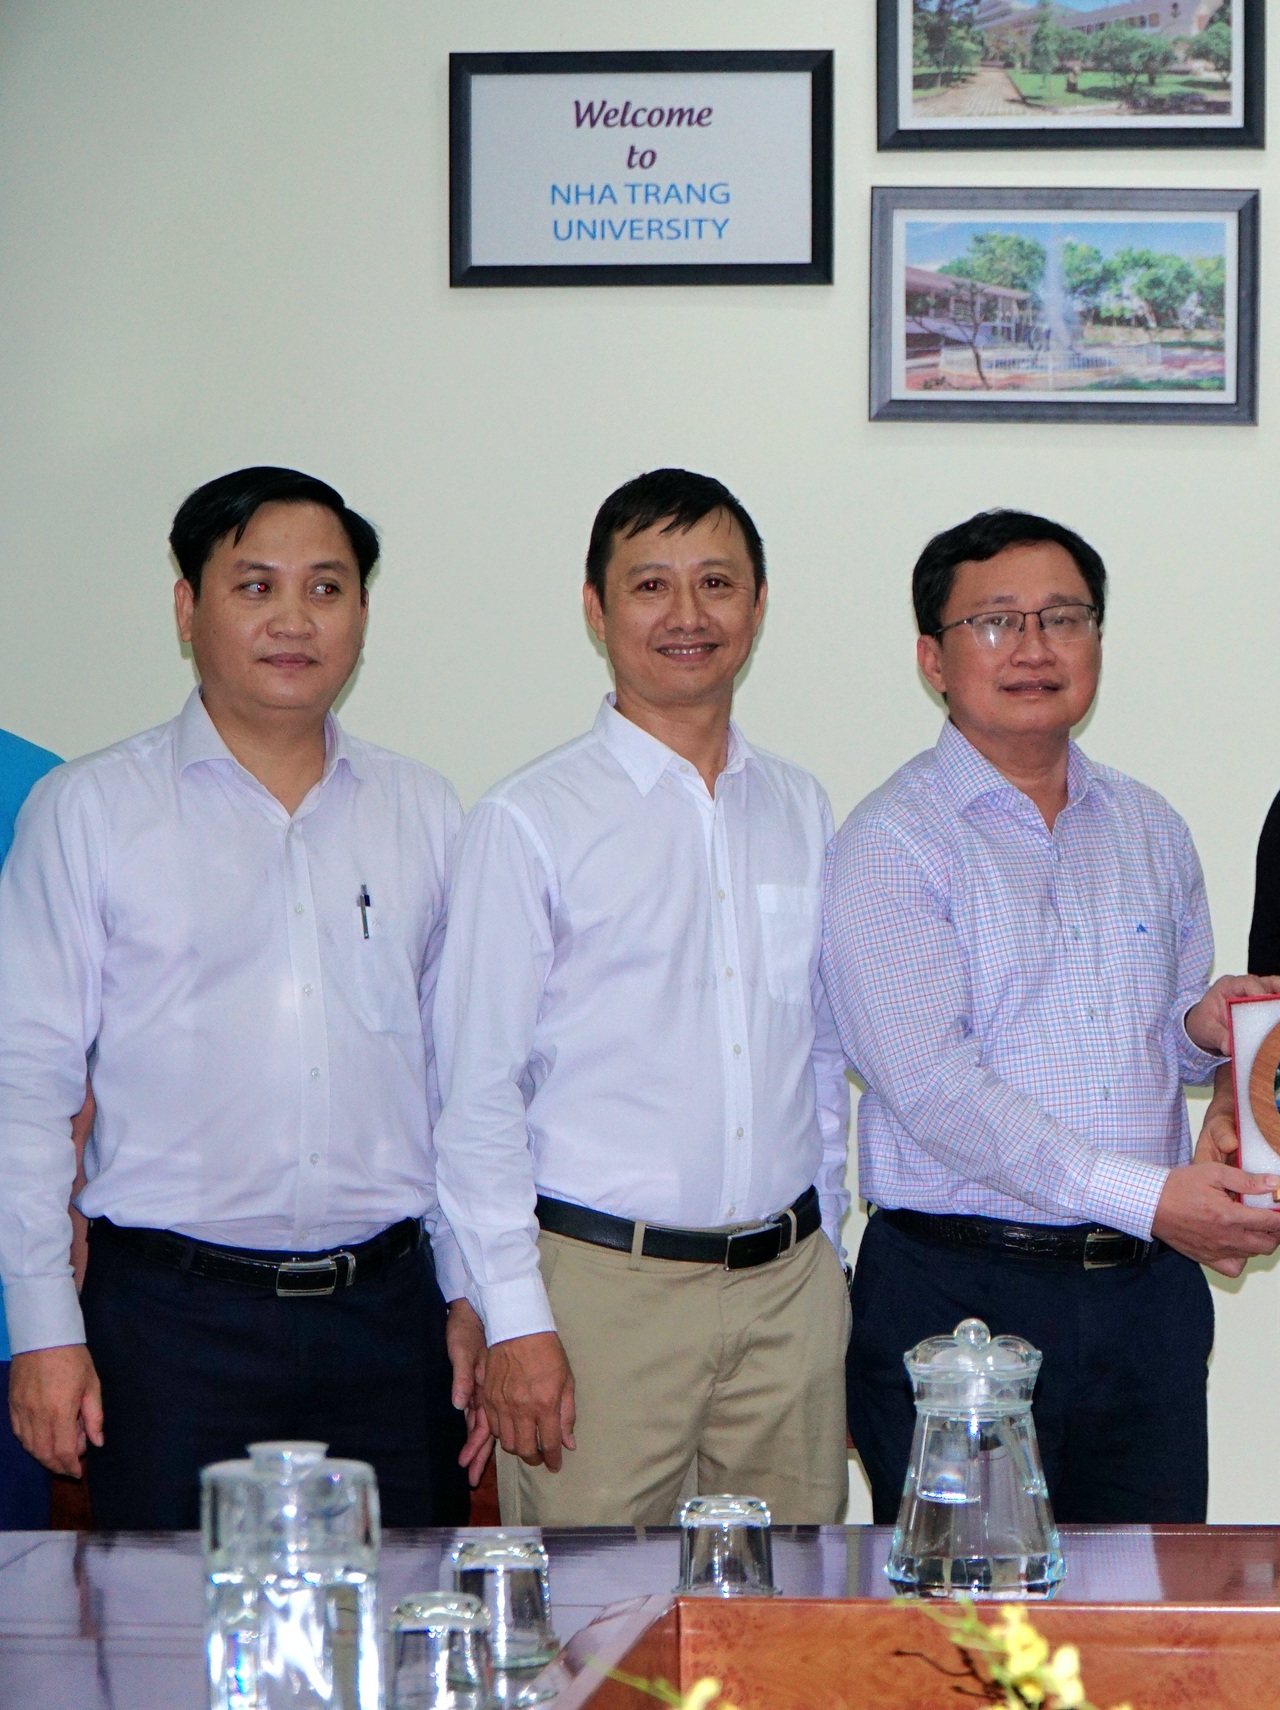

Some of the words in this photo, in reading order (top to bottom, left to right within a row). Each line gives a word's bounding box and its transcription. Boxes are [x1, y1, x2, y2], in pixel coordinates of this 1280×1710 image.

[573, 99, 714, 129] Welcome
[626, 145, 658, 169] to
[550, 183, 618, 206] NHA
[625, 182, 732, 206] TRANG
[553, 217, 731, 241] UNIVERSITY
